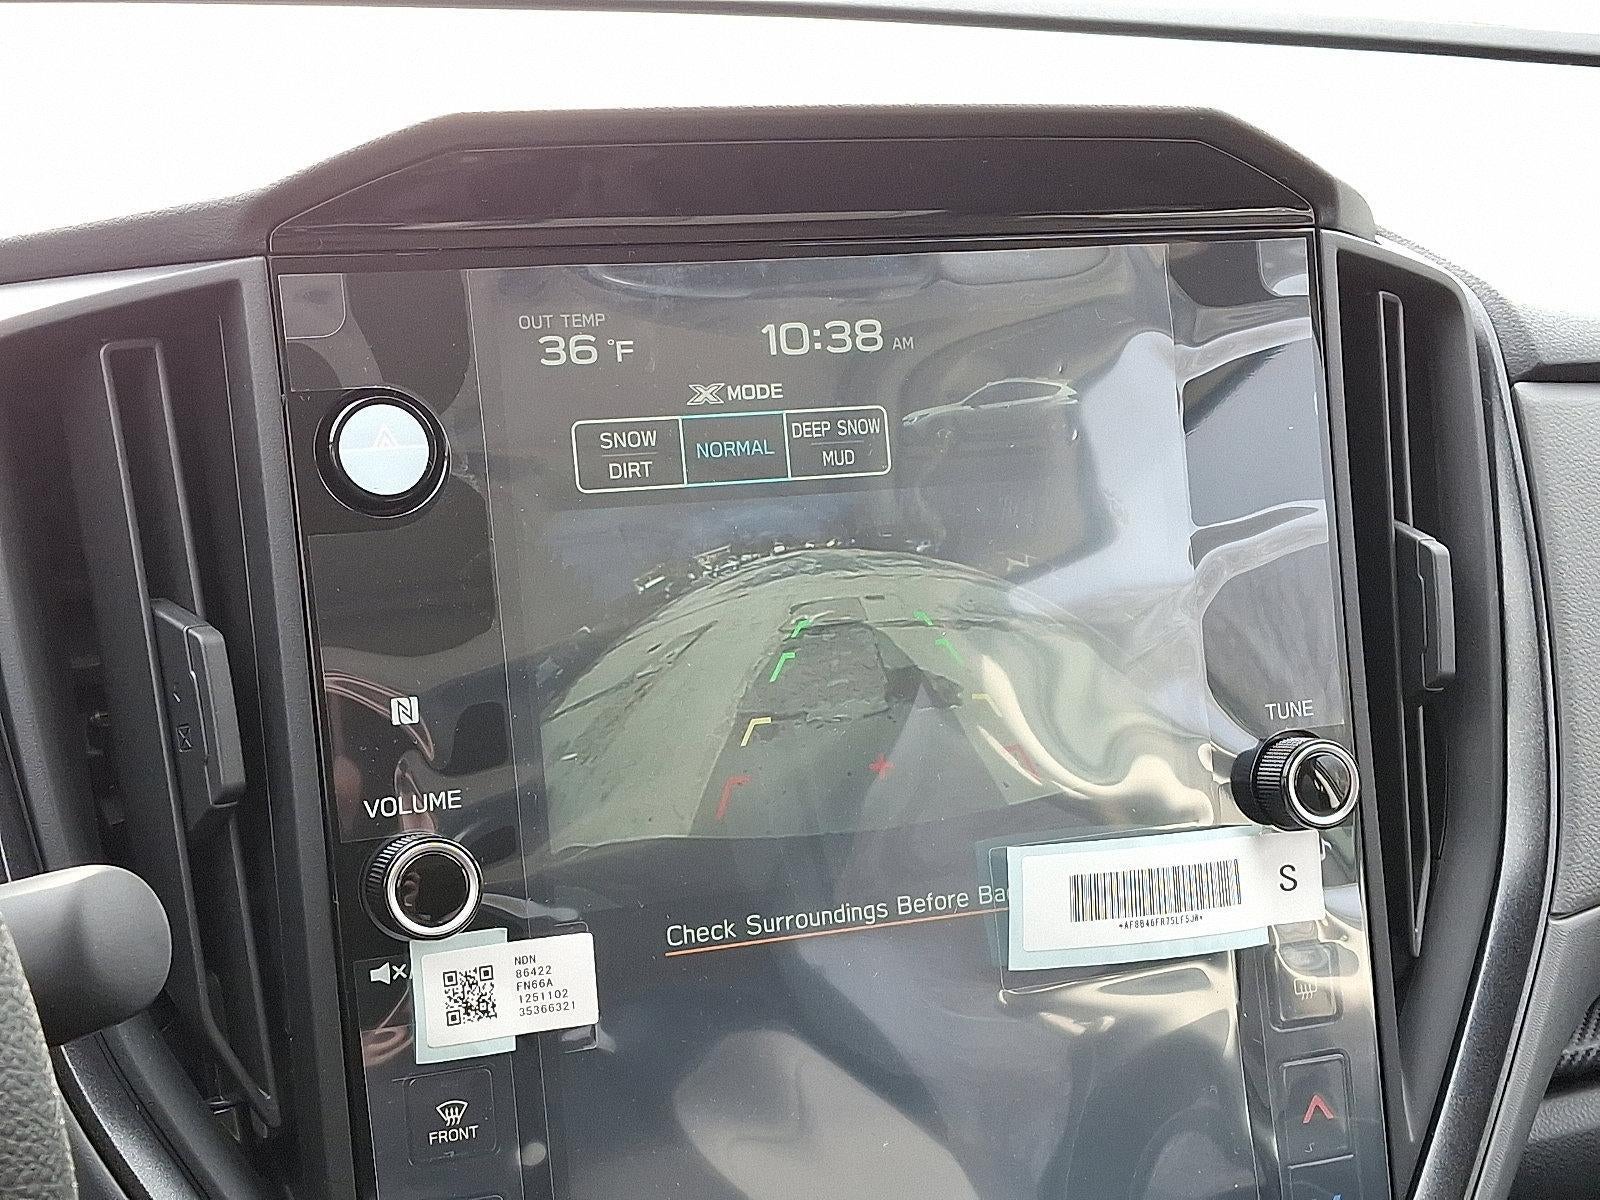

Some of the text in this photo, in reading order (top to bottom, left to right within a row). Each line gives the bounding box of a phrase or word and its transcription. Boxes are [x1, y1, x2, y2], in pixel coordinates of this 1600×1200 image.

[518, 313, 606, 330] OUT TEMP
[761, 319, 915, 357] 10:38 AM
[538, 335, 598, 366] 36
[727, 383, 784, 401] MODE
[791, 418, 881, 438] DEEP SNOW
[599, 430, 658, 450] SNOW
[696, 438, 776, 460] NORMAL
[822, 449, 856, 467] MUD
[608, 460, 653, 480] DIRT
[1264, 699, 1314, 720] TUNE
[363, 789, 463, 820] VOLUME
[1279, 864, 1298, 892] S
[666, 885, 1009, 947] Check Surroundings Before Ba
[514, 954, 537, 966] NDN
[515, 965, 553, 979] 86422
[516, 979, 554, 992] FN66A
[519, 1001, 576, 1017] 35366321
[428, 1124, 479, 1146] FRONT
